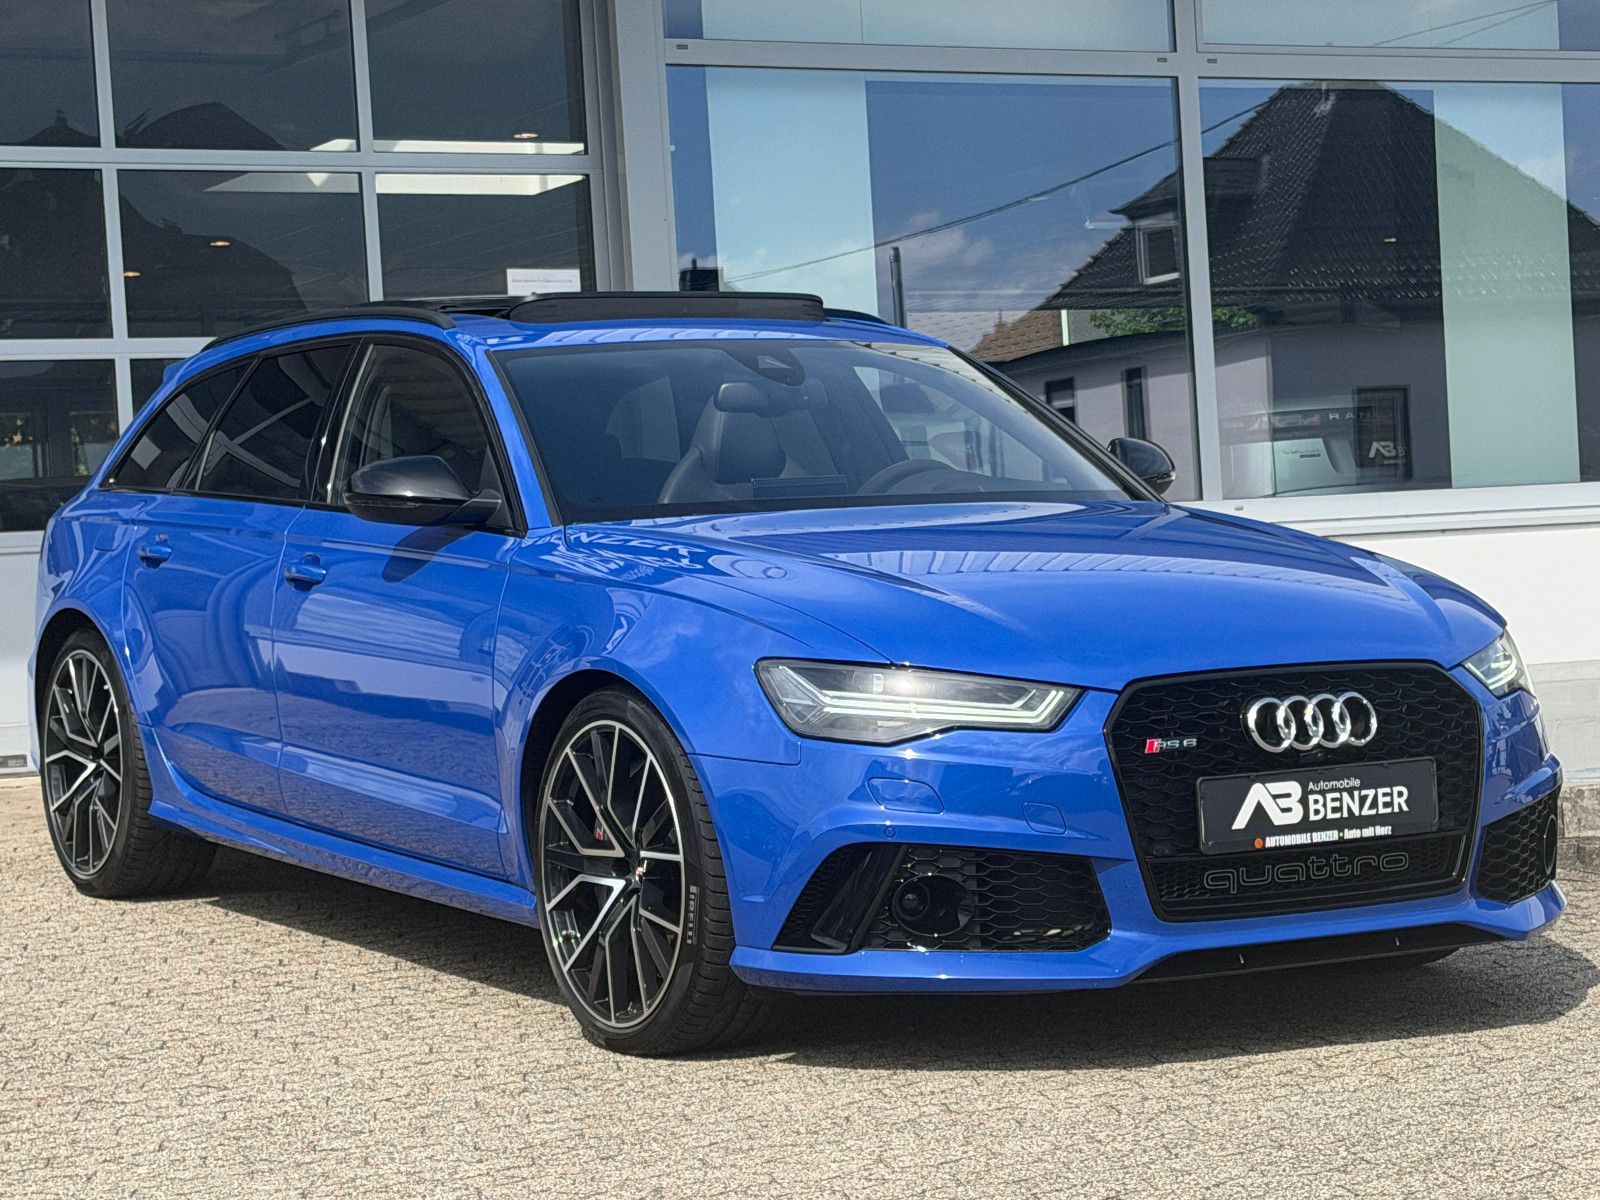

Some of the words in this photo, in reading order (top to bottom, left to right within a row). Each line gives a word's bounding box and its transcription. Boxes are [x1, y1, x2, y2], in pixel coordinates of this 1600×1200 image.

[1308, 777, 1361, 791] Automobile
[1231, 780, 1303, 830] AB
[1308, 785, 1409, 822] BENZER
[1265, 832, 1311, 848] AUTOMOBILE
[1312, 830, 1339, 843] BENZER
[1362, 825, 1375, 838] mit
[1204, 852, 1409, 894] quattro
